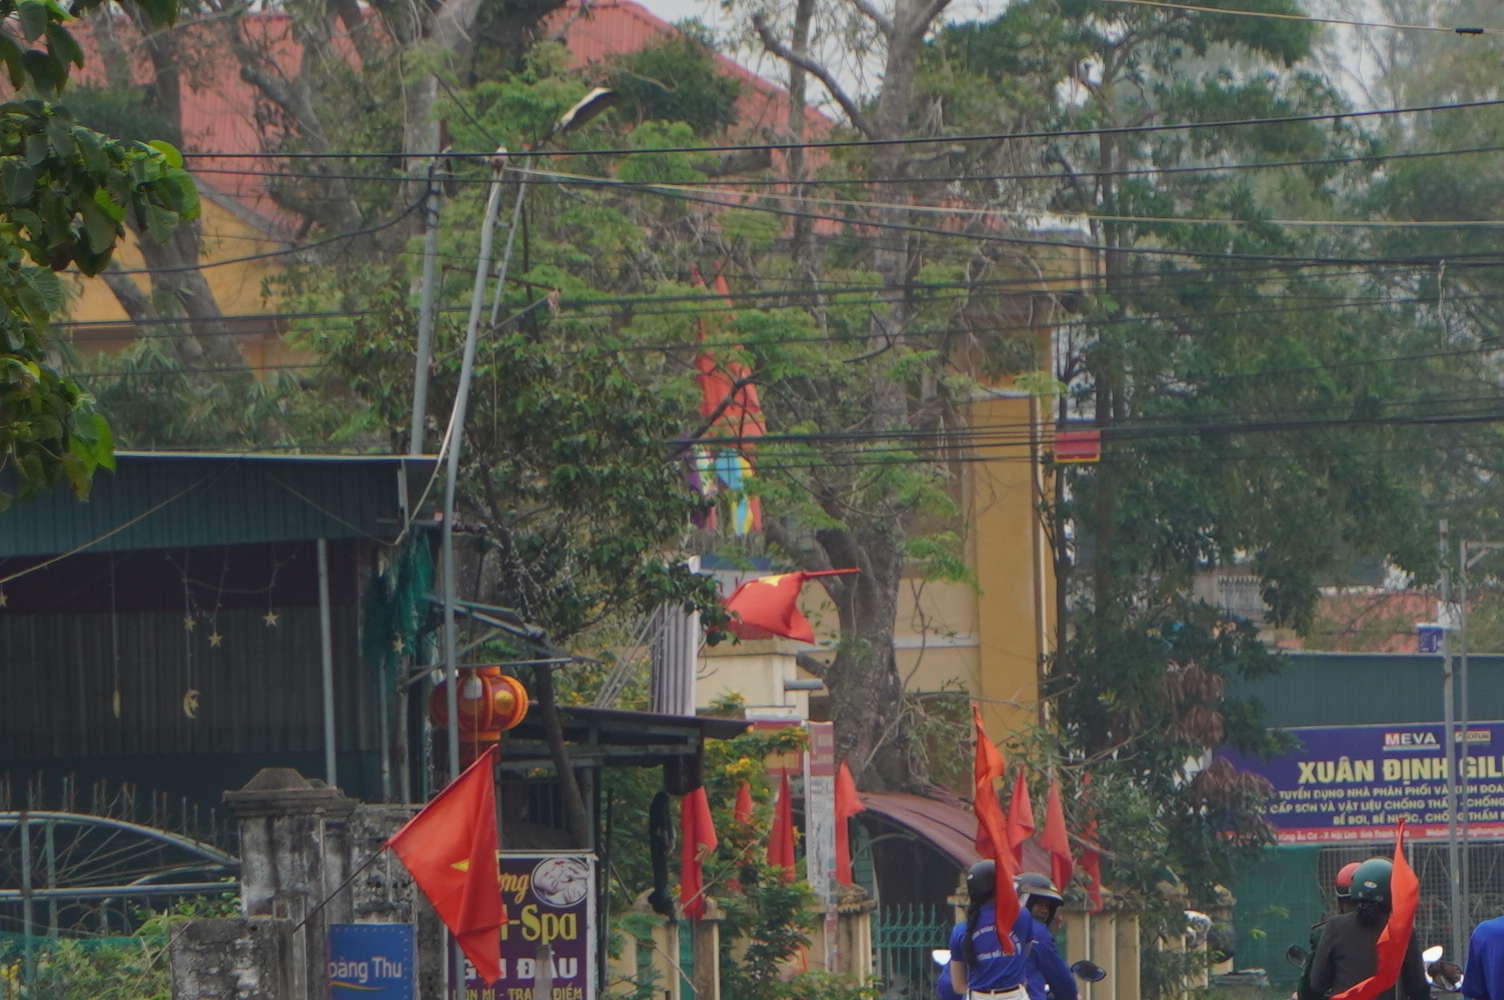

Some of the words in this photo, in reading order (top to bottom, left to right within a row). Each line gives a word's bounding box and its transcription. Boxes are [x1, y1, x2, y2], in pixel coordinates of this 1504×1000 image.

[1385, 732, 1436, 745] MEVA
[1298, 756, 1374, 784] XUÂN
[1383, 757, 1448, 785] ĐỊNH
[1314, 788, 1344, 800] DỤNG
[1347, 786, 1370, 797] NHÀ
[1405, 783, 1431, 795] PHỐI
[1320, 801, 1335, 812] VÀ
[1384, 797, 1425, 809] CHỐNG
[1428, 796, 1452, 808] THẤ
[1425, 810, 1465, 822] CHỐG
[1469, 808, 1498, 820] THẤM
[371, 955, 402, 978] Thu
